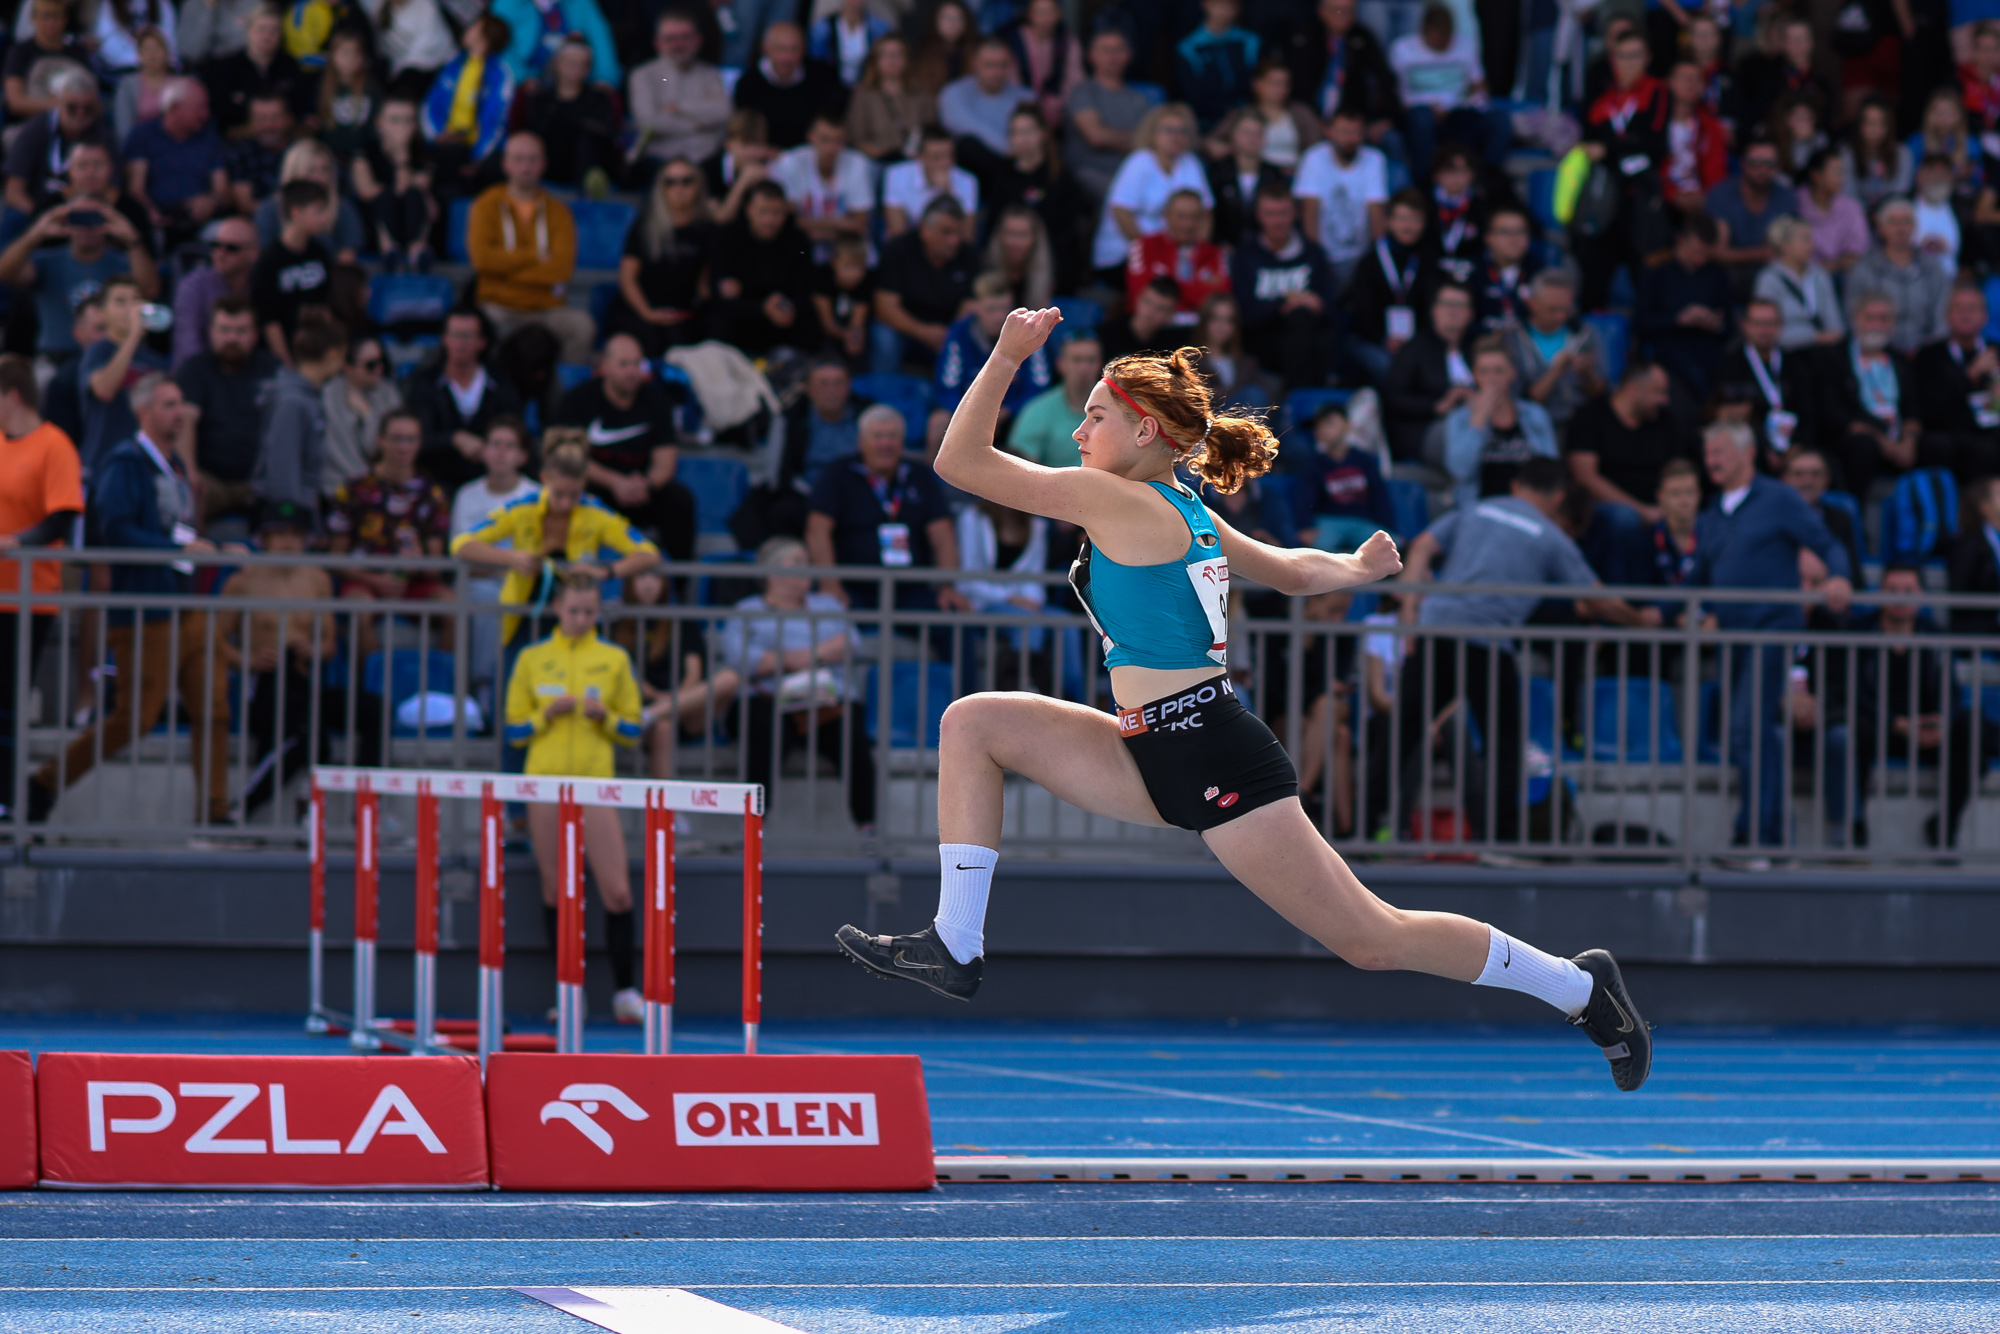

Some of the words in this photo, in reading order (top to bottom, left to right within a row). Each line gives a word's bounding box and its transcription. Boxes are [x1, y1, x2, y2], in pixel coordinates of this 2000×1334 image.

[1161, 685, 1217, 720] PRO
[87, 1080, 448, 1155] PZLA
[686, 1101, 864, 1138] ORLEN
